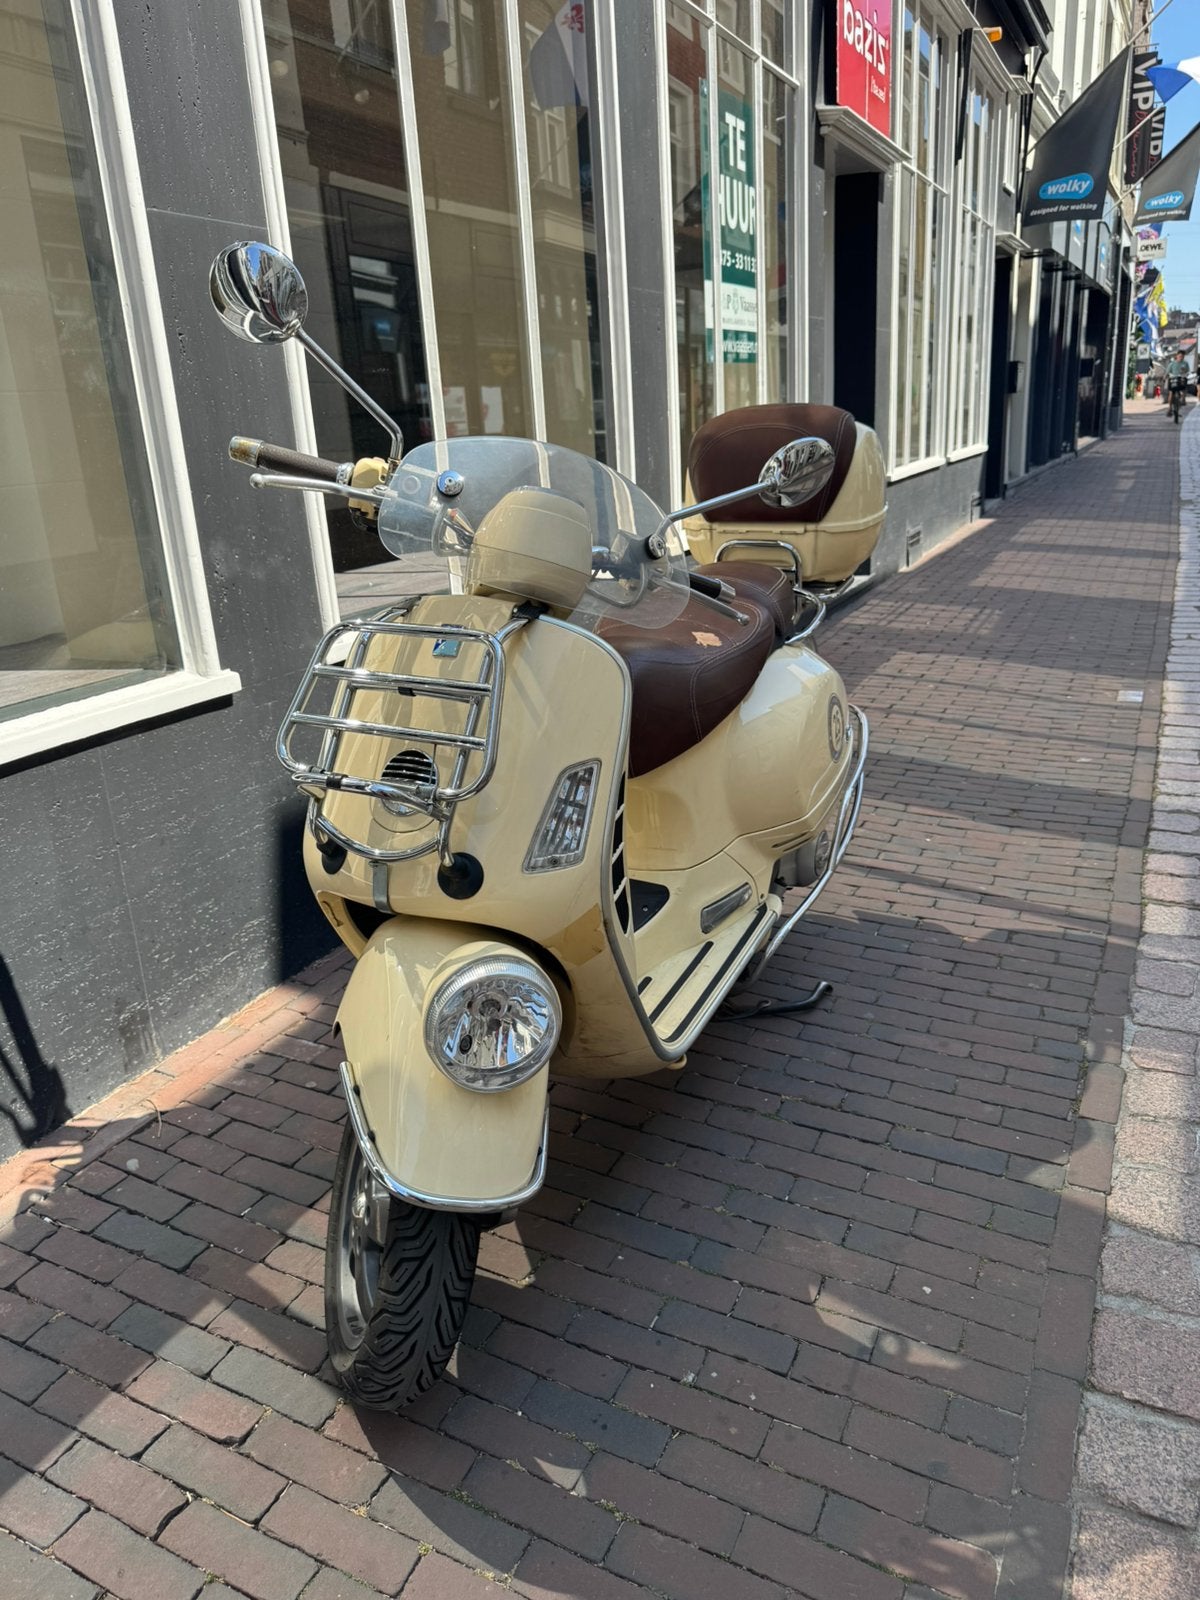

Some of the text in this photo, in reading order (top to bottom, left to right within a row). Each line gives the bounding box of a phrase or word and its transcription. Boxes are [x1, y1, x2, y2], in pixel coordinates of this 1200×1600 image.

[1132, 57, 1157, 111] VIP
[725, 111, 746, 172] TE
[1047, 179, 1091, 195] wolky
[1151, 194, 1182, 206] wolky
[1030, 205, 1058, 217] designed
[1060, 204, 1069, 212] for
